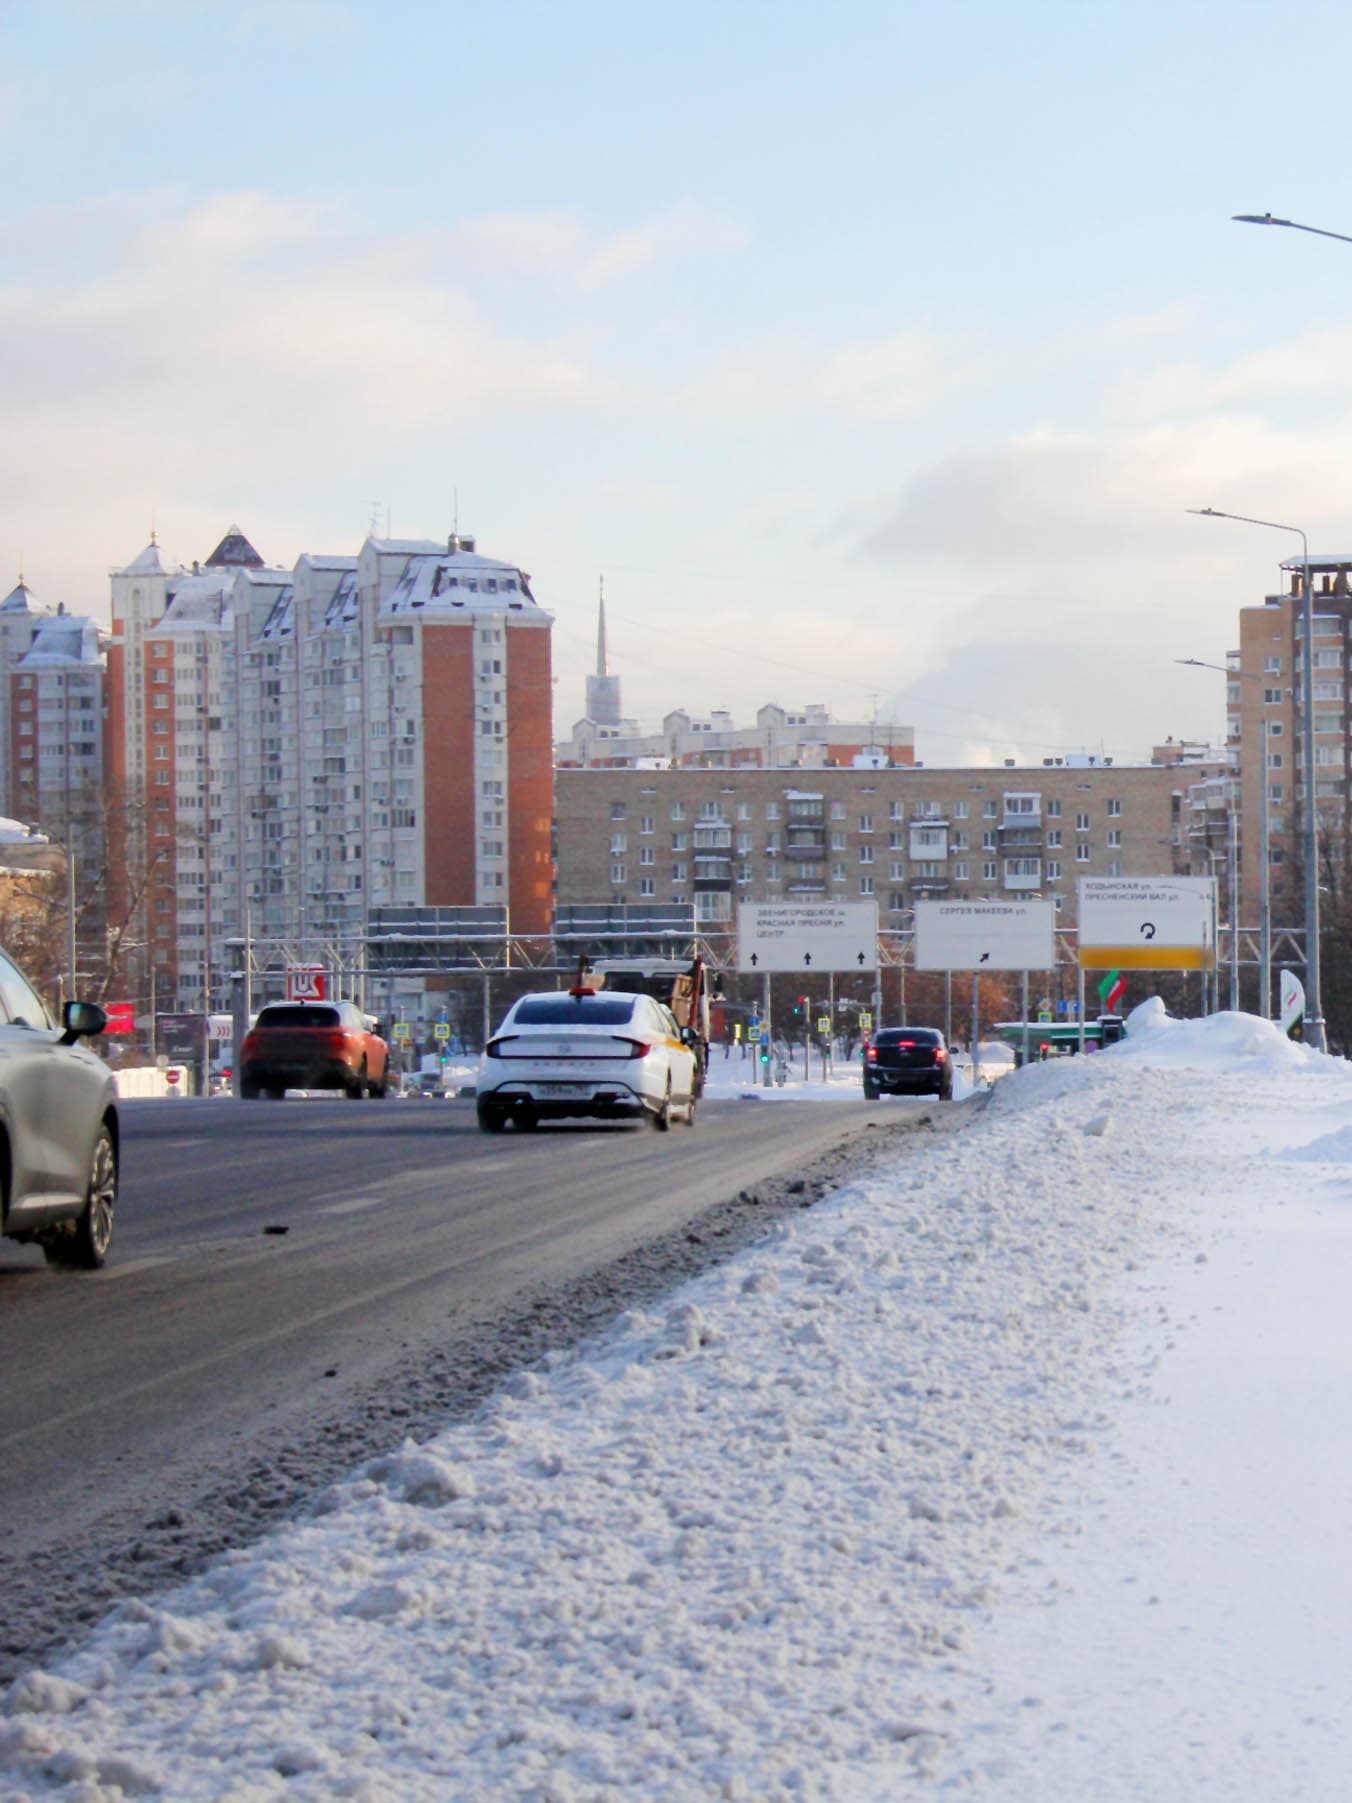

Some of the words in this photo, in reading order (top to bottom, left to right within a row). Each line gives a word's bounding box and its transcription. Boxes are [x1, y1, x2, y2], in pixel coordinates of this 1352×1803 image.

[1150, 892, 1167, 901] ВАЛ
[758, 908, 835, 917] ЗВЕНИГОРОДСКОЕ
[939, 907, 972, 916] СЕРГЕЯ
[974, 907, 1013, 916] МАКЕЕВА
[757, 919, 796, 927] КРАСНАЯ
[798, 919, 832, 927] ПРЕСНЯ
